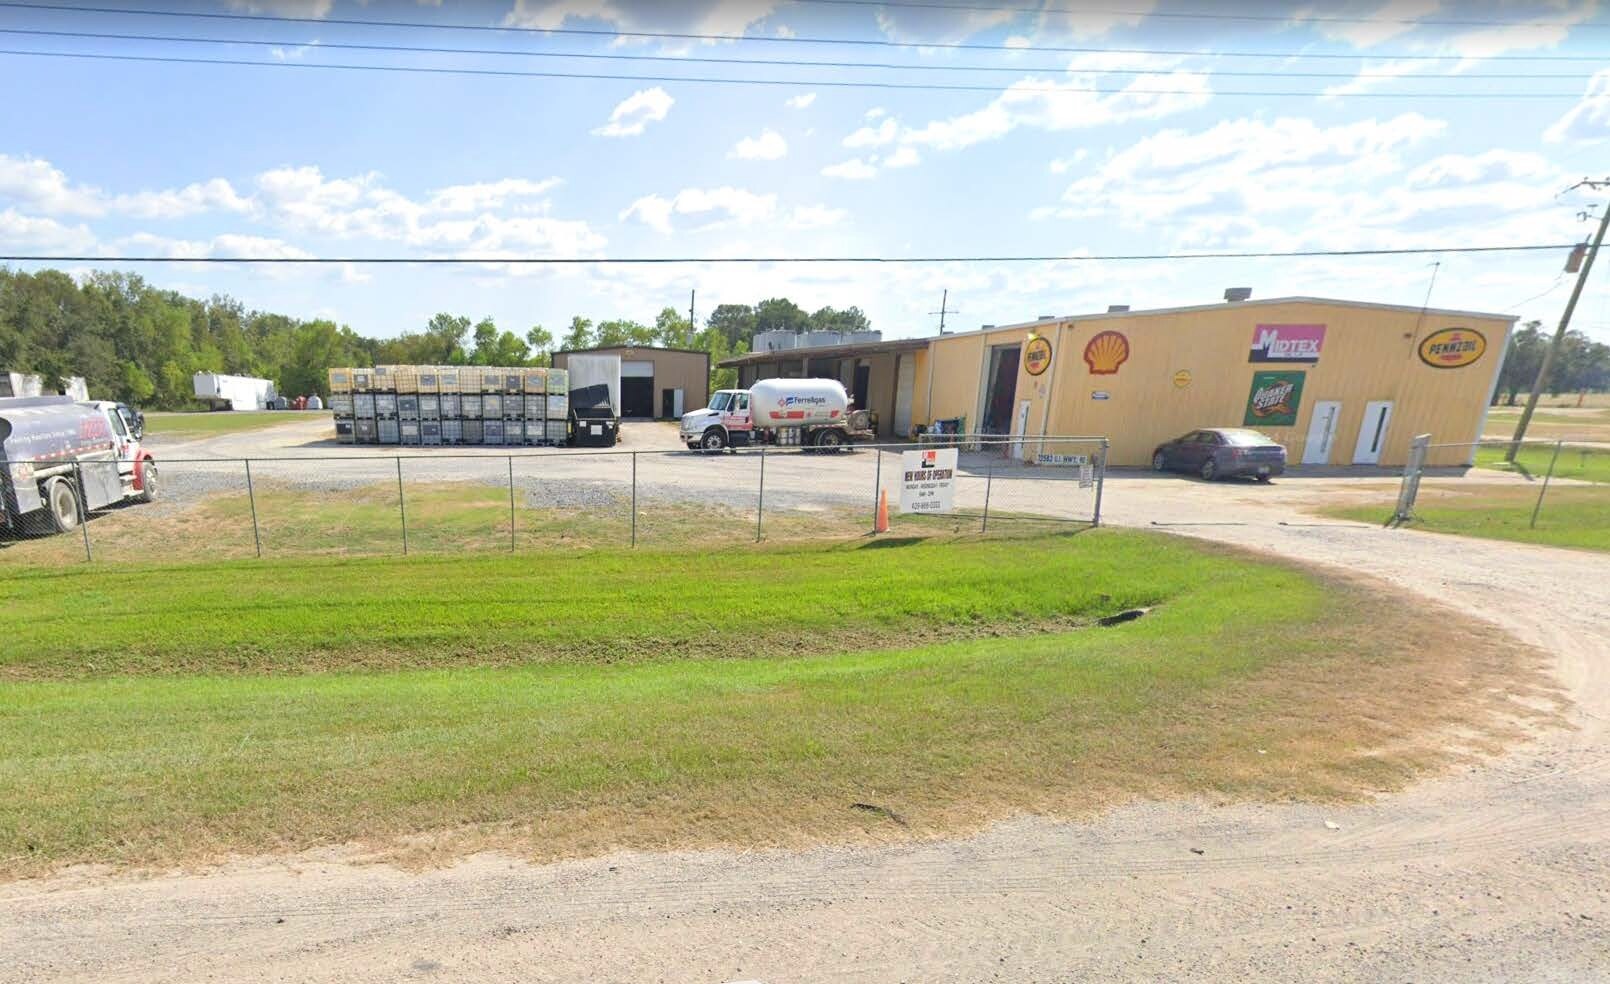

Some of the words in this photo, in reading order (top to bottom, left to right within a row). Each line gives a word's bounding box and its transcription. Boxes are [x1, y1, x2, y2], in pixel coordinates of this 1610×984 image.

[1258, 328, 1319, 357] MIDTEX
[1428, 341, 1476, 355] PENNZOIL
[1253, 383, 1295, 404] QUAKER
[1257, 395, 1284, 410] STATE
[914, 470, 927, 481] HOURS
[927, 470, 932, 480] OF
